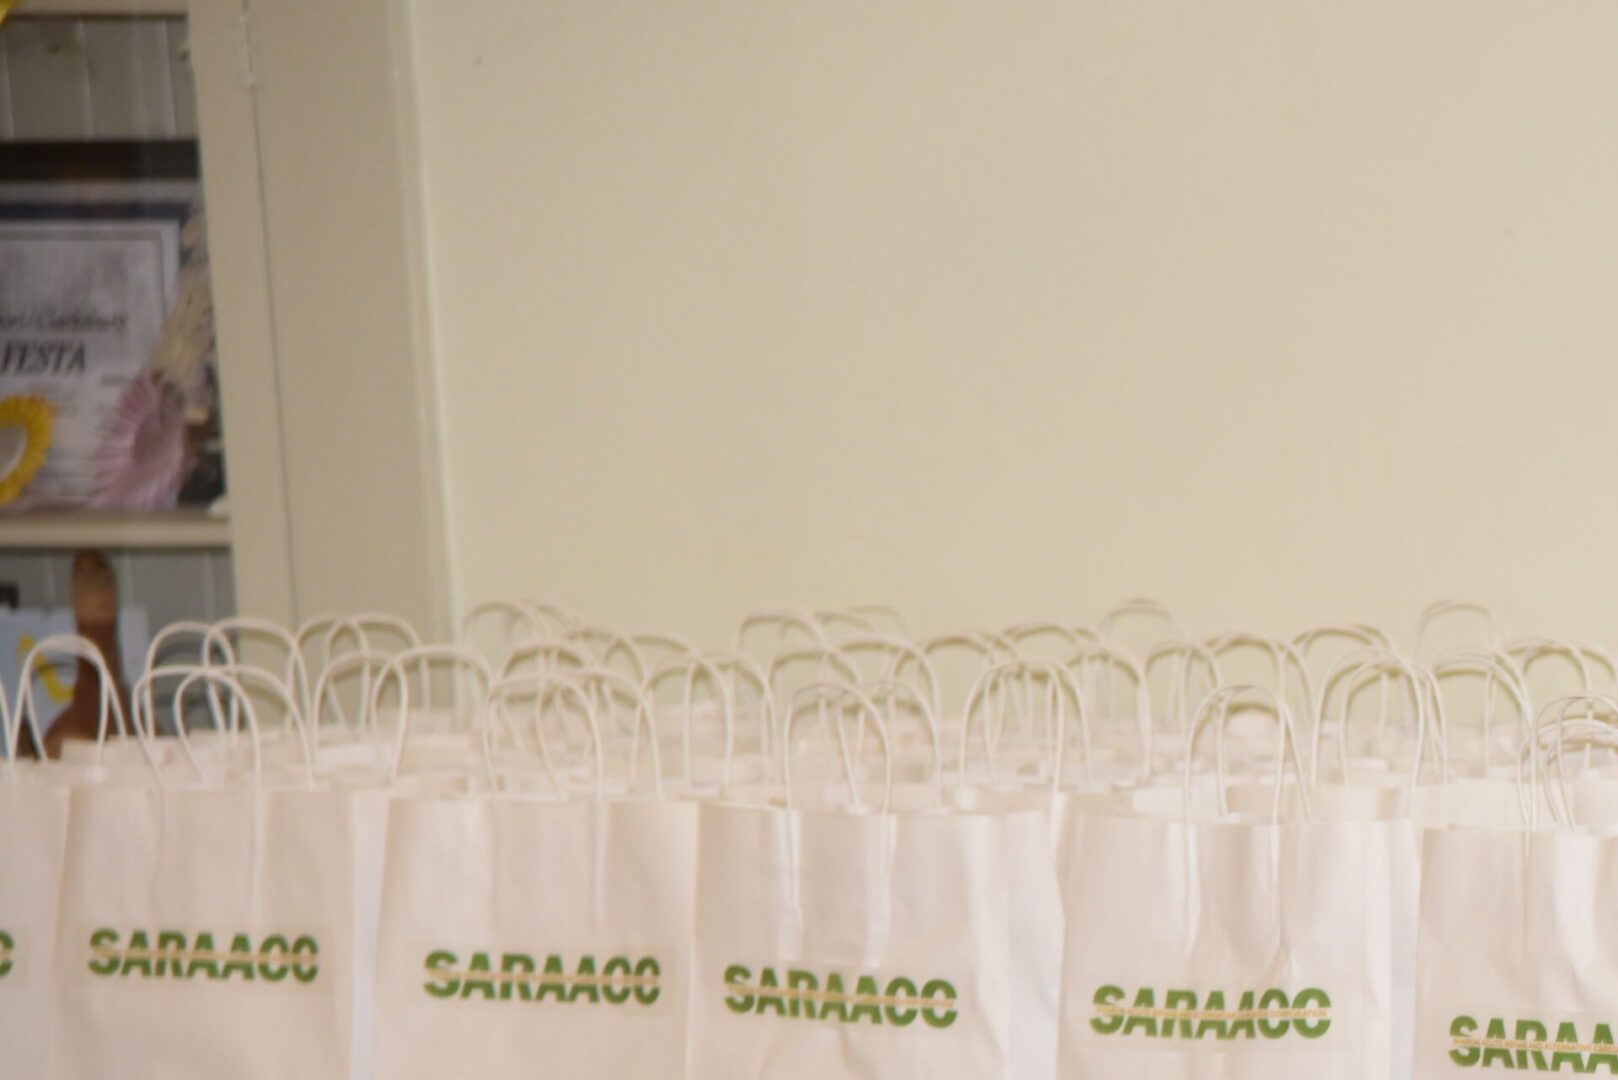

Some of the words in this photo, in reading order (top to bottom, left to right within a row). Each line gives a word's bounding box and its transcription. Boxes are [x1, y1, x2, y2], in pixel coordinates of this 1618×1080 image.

[88, 928, 319, 983] SARAACC
[423, 950, 660, 1005] SARAACC
[723, 964, 958, 1029] SARAACC
[1089, 984, 1332, 1039] SARAACC
